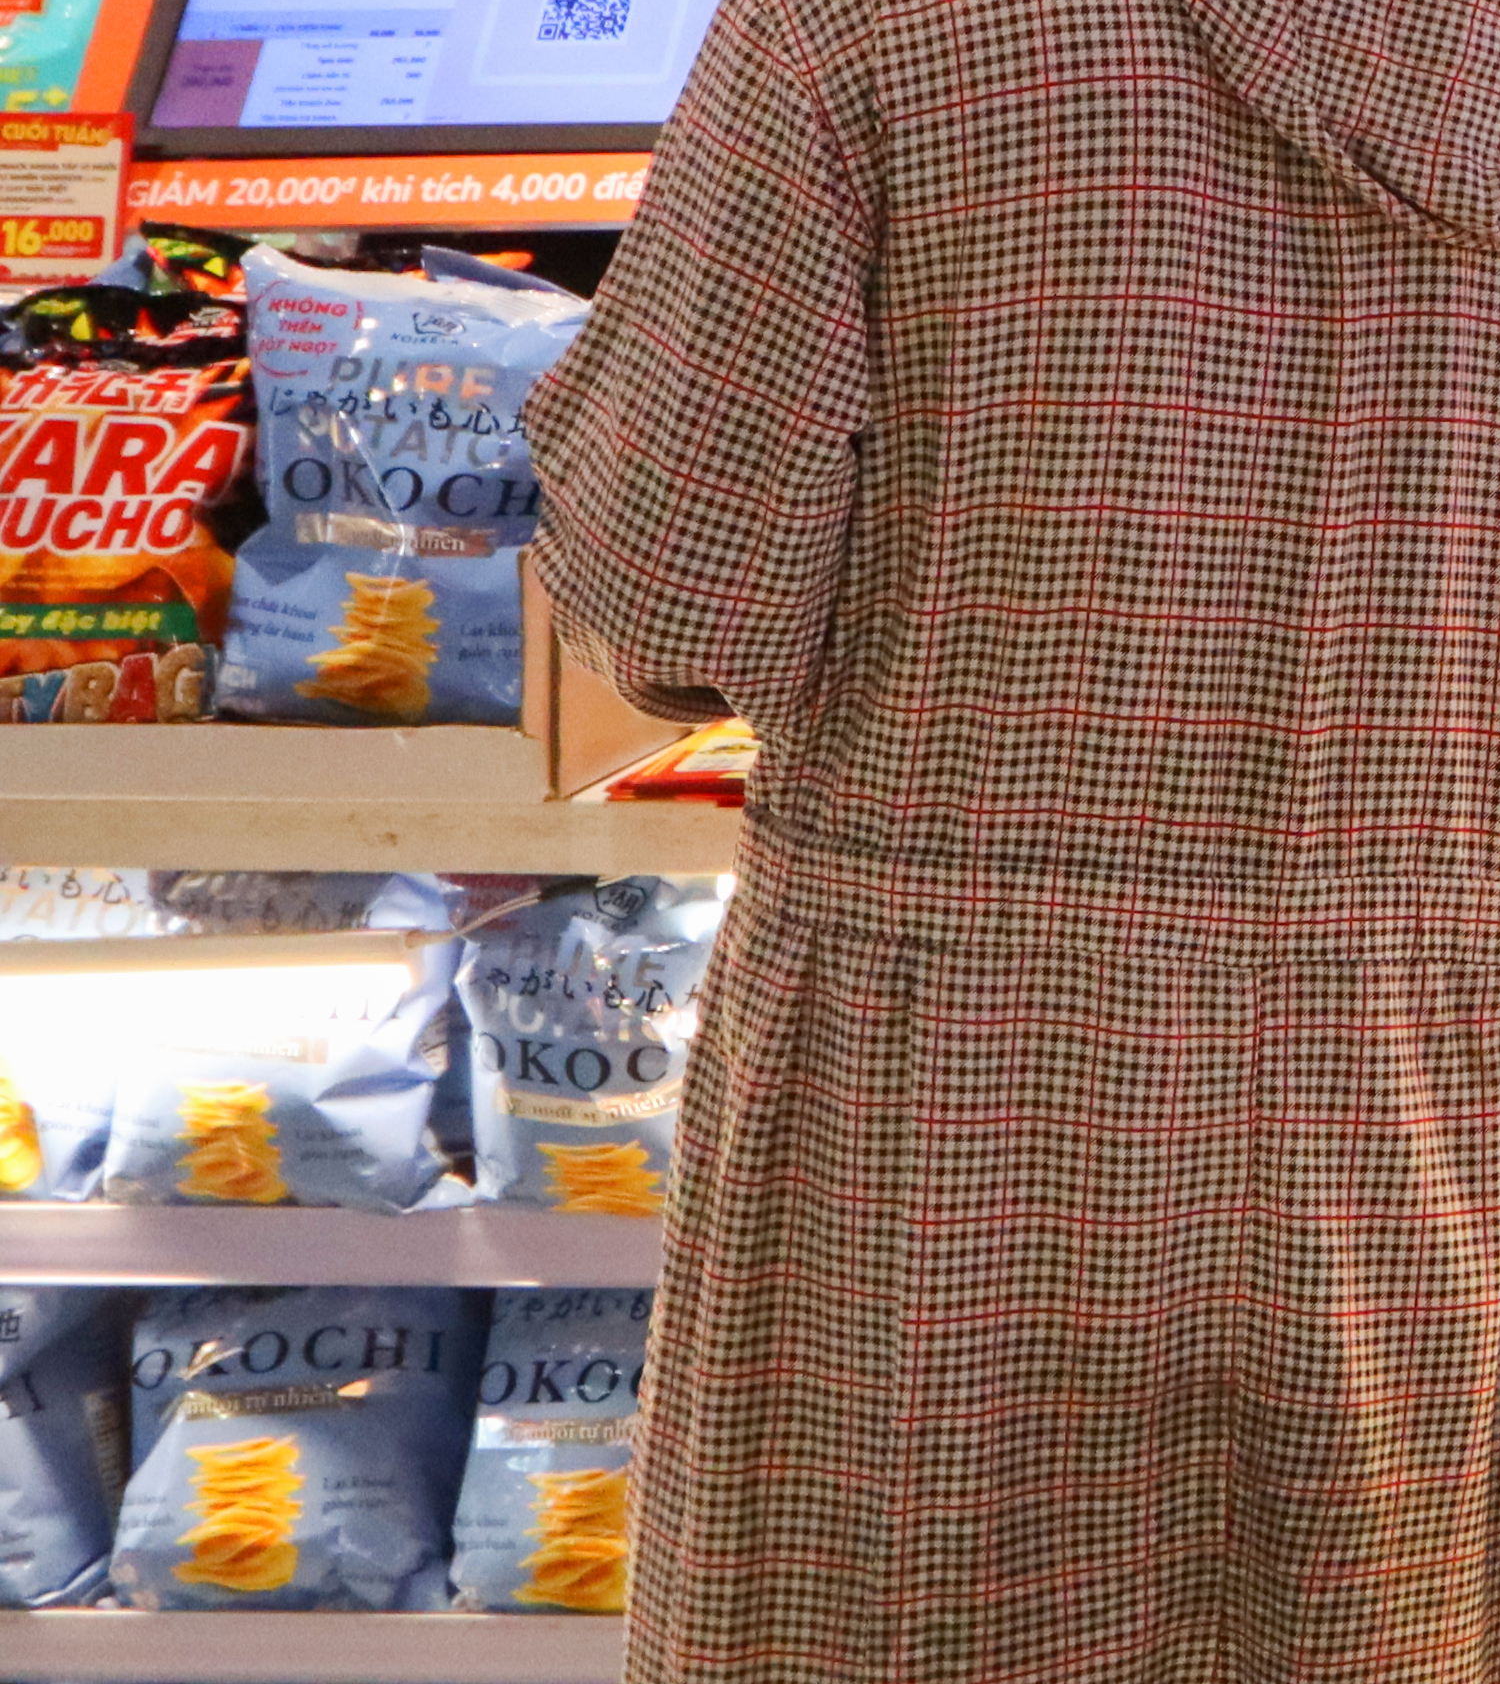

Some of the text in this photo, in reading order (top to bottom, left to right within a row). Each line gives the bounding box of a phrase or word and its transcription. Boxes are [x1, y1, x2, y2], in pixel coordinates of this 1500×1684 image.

[360, 171, 588, 208] khi tích 4,000
